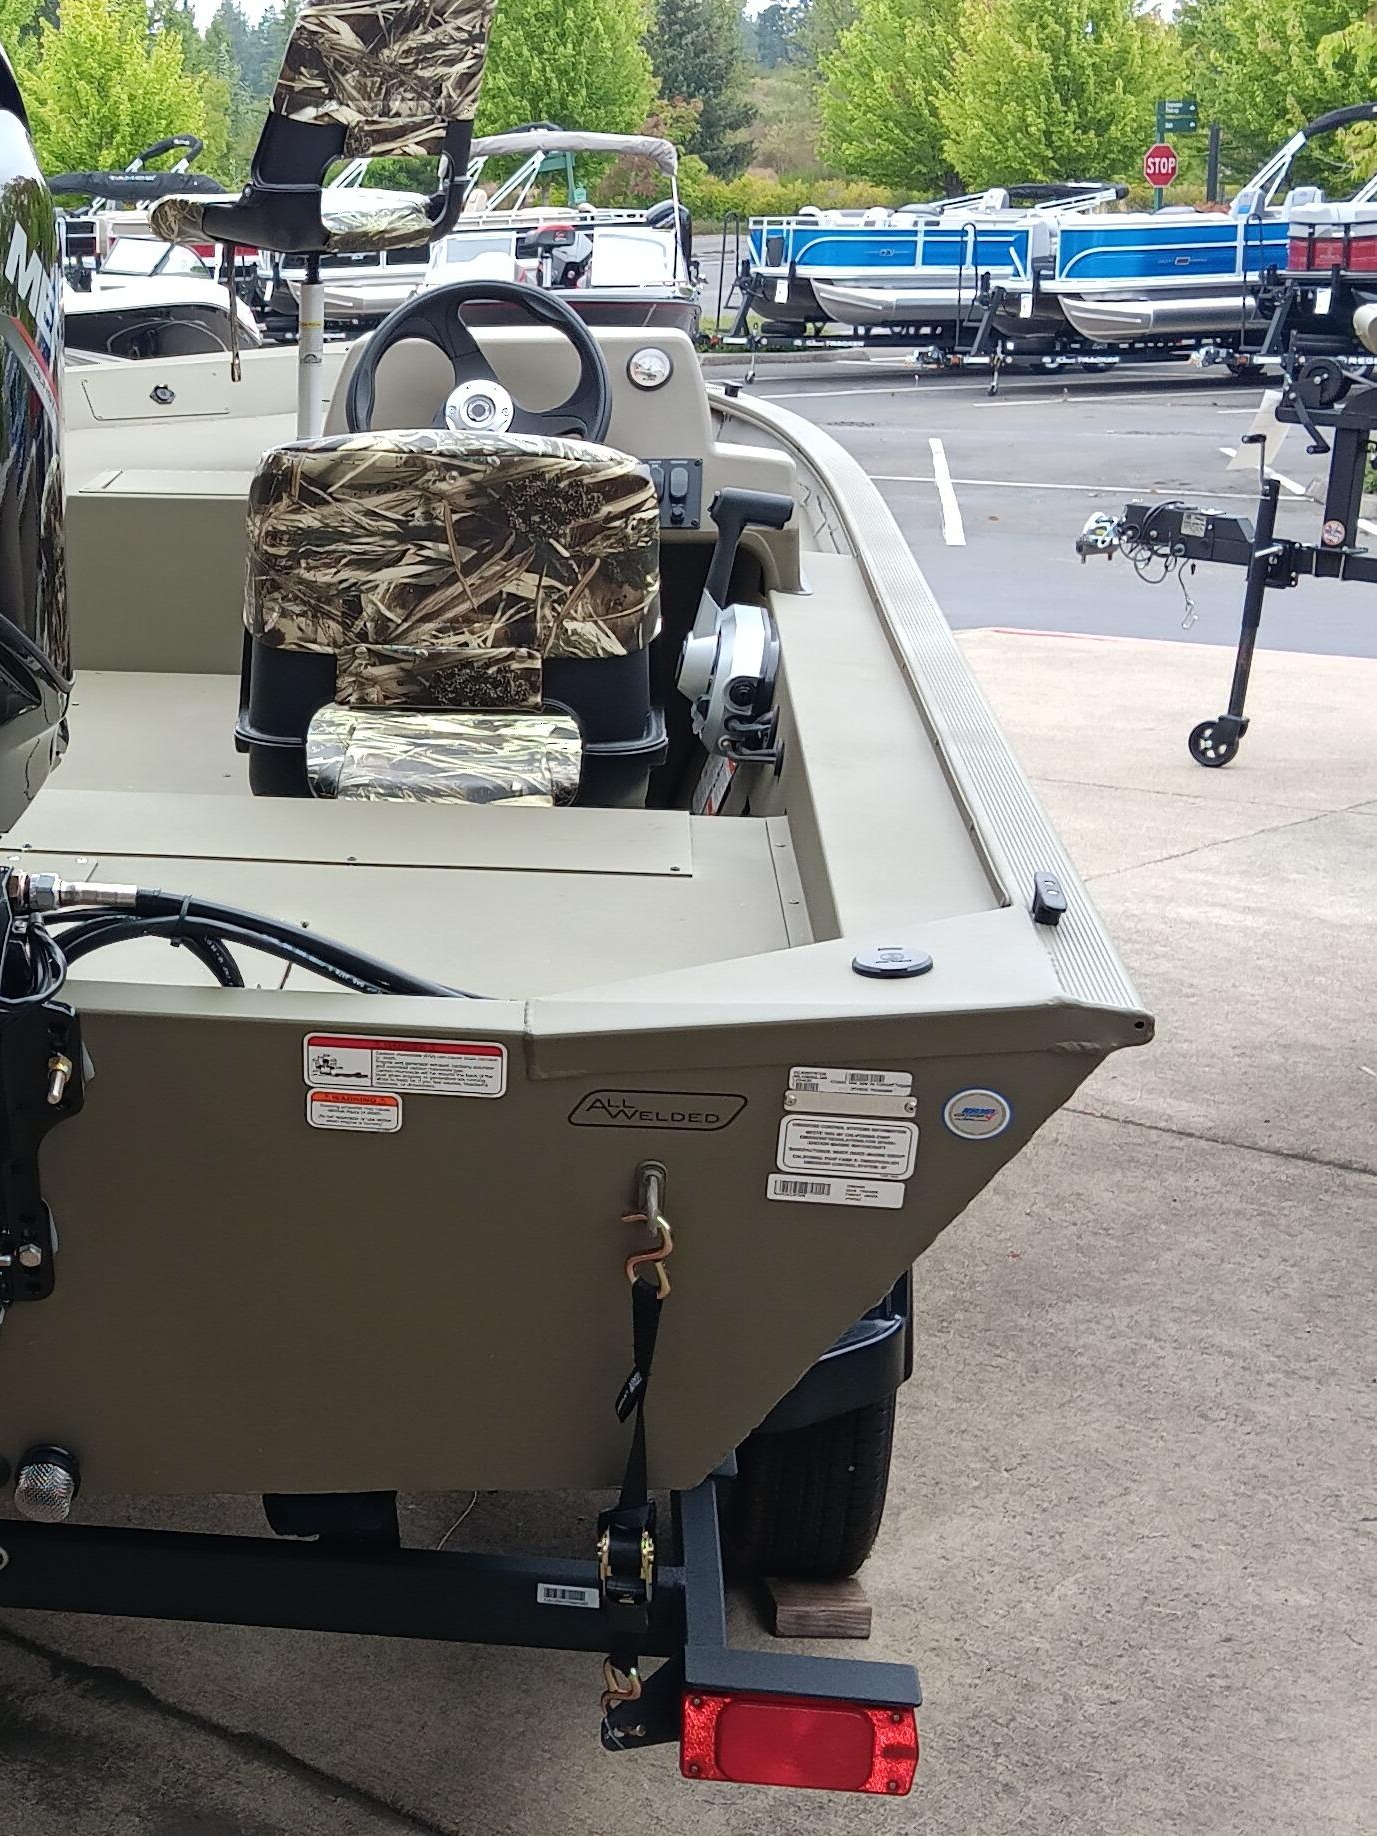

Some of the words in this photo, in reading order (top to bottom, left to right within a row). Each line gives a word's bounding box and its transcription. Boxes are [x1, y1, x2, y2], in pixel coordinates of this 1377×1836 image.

[1146, 157, 1176, 174] STOP
[586, 1098, 635, 1112] ALL
[604, 1109, 720, 1124] WELDED
